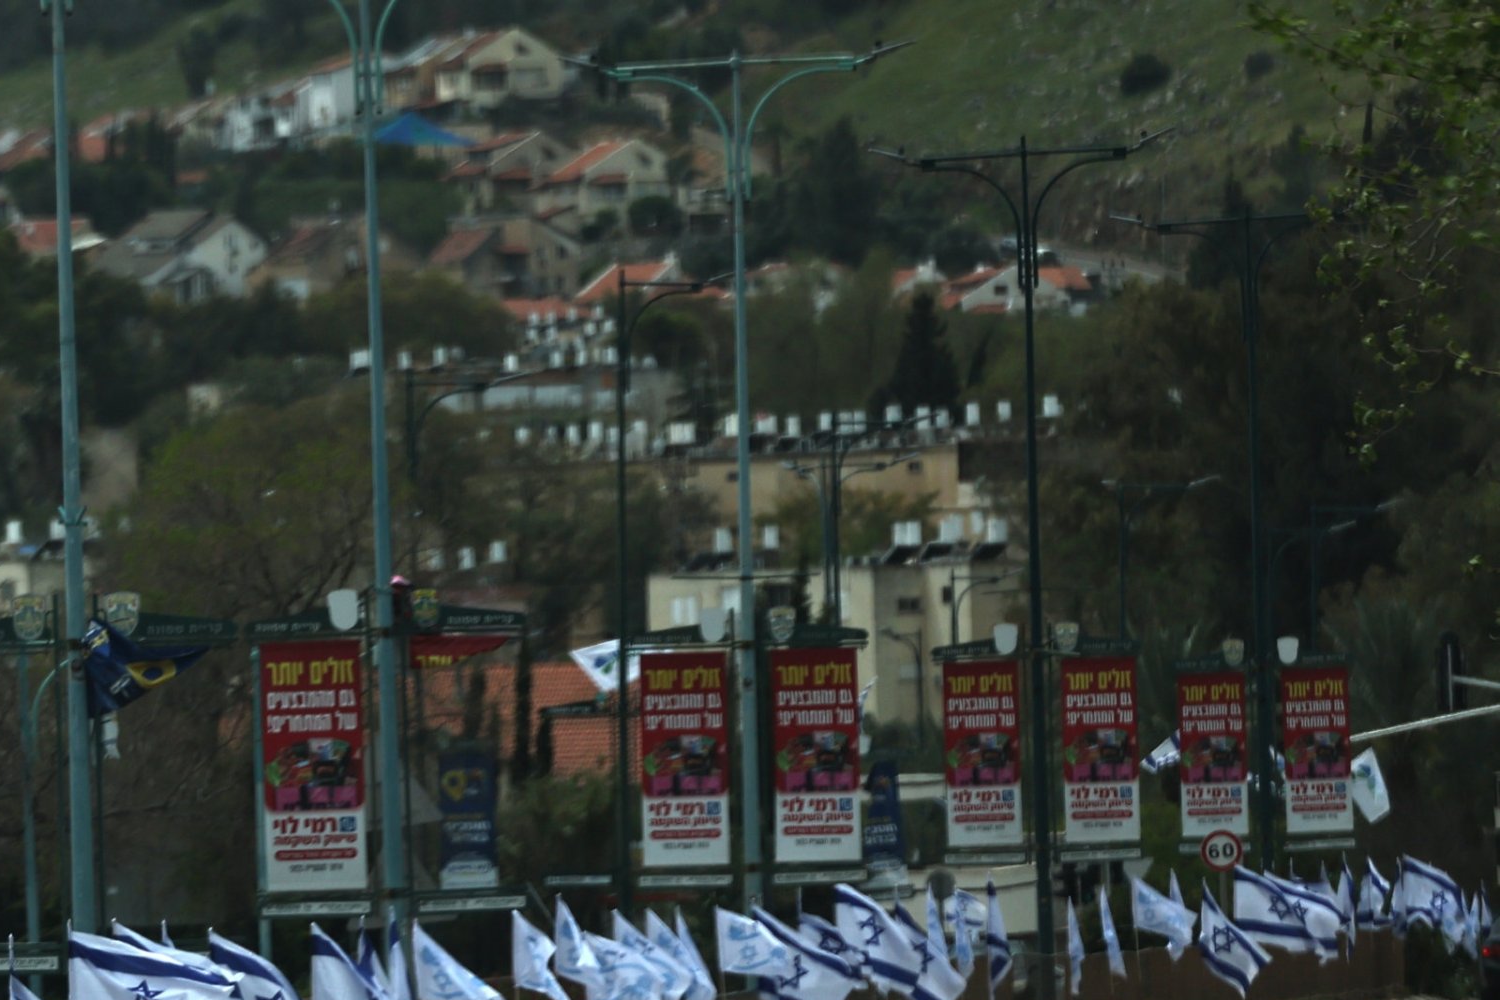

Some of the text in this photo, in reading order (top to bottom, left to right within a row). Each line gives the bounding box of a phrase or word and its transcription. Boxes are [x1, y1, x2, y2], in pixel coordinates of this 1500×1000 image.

[266, 656, 355, 687] זולים יותר
[645, 666, 720, 691] זולים יותר
[776, 661, 852, 687] זולים יותר
[1066, 669, 1132, 691] זולים יותר
[947, 673, 1013, 695] זולים יותר
[1183, 682, 1241, 704] זולים יותר
[1285, 677, 1344, 700] זולים יותר
[267, 689, 357, 711] גם מהמבצעים
[645, 692, 722, 712] גם מהמבצעים
[777, 688, 852, 707] גם מהמבצעים
[1002, 695, 1014, 709] גם
[1120, 692, 1132, 707] גם
[335, 711, 358, 731] של
[703, 711, 723, 729] של
[835, 707, 854, 725] של
[998, 712, 1016, 727] של
[1117, 708, 1134, 724] של
[649, 801, 705, 816] רמי לוי
[782, 796, 837, 812] רמי לוי
[273, 815, 338, 834] רמי לוי
[1208, 843, 1235, 859] 60
